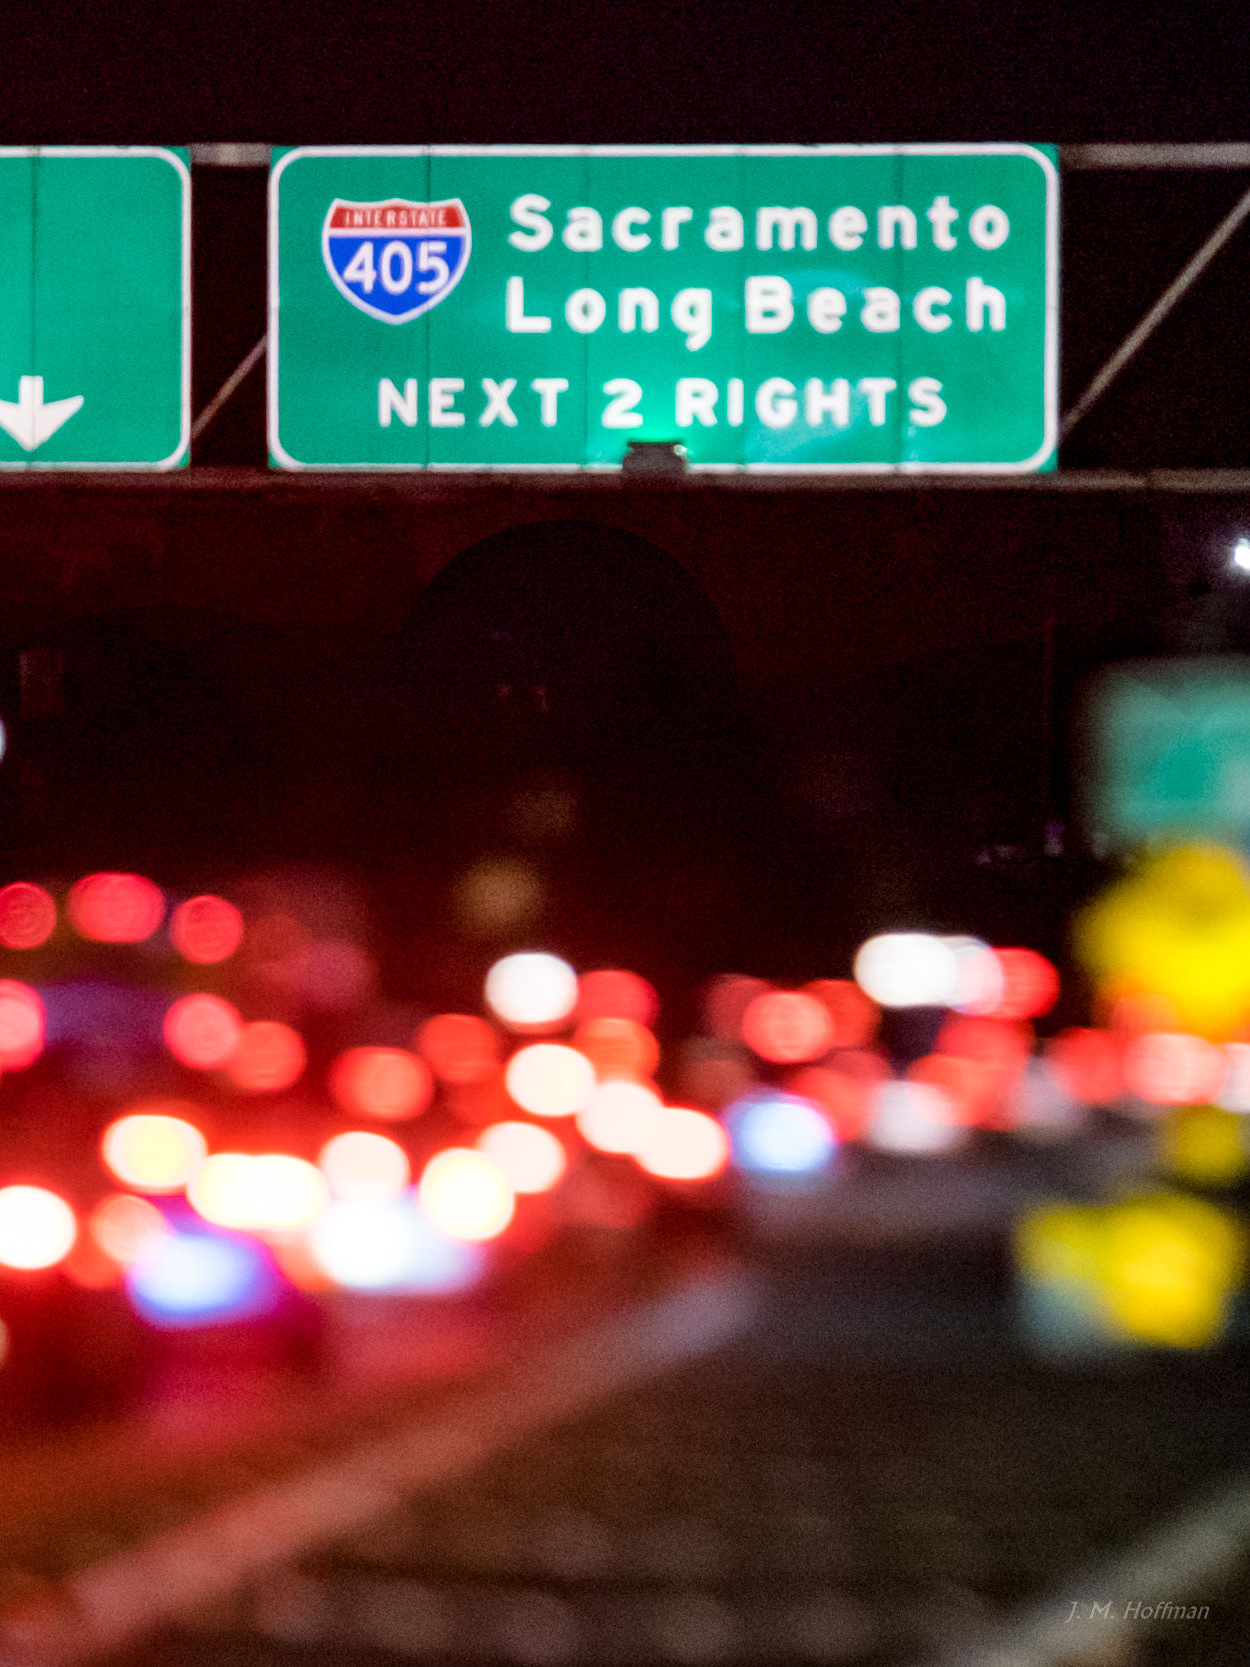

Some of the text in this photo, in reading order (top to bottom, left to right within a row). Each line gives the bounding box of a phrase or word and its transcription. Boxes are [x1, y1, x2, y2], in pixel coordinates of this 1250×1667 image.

[344, 211, 448, 226] INTERSTATE
[508, 194, 1011, 253] Sacramento
[342, 240, 450, 295] 405
[505, 275, 1007, 351] Long Beach
[378, 377, 947, 427] NEXT 2 RIGHTS
